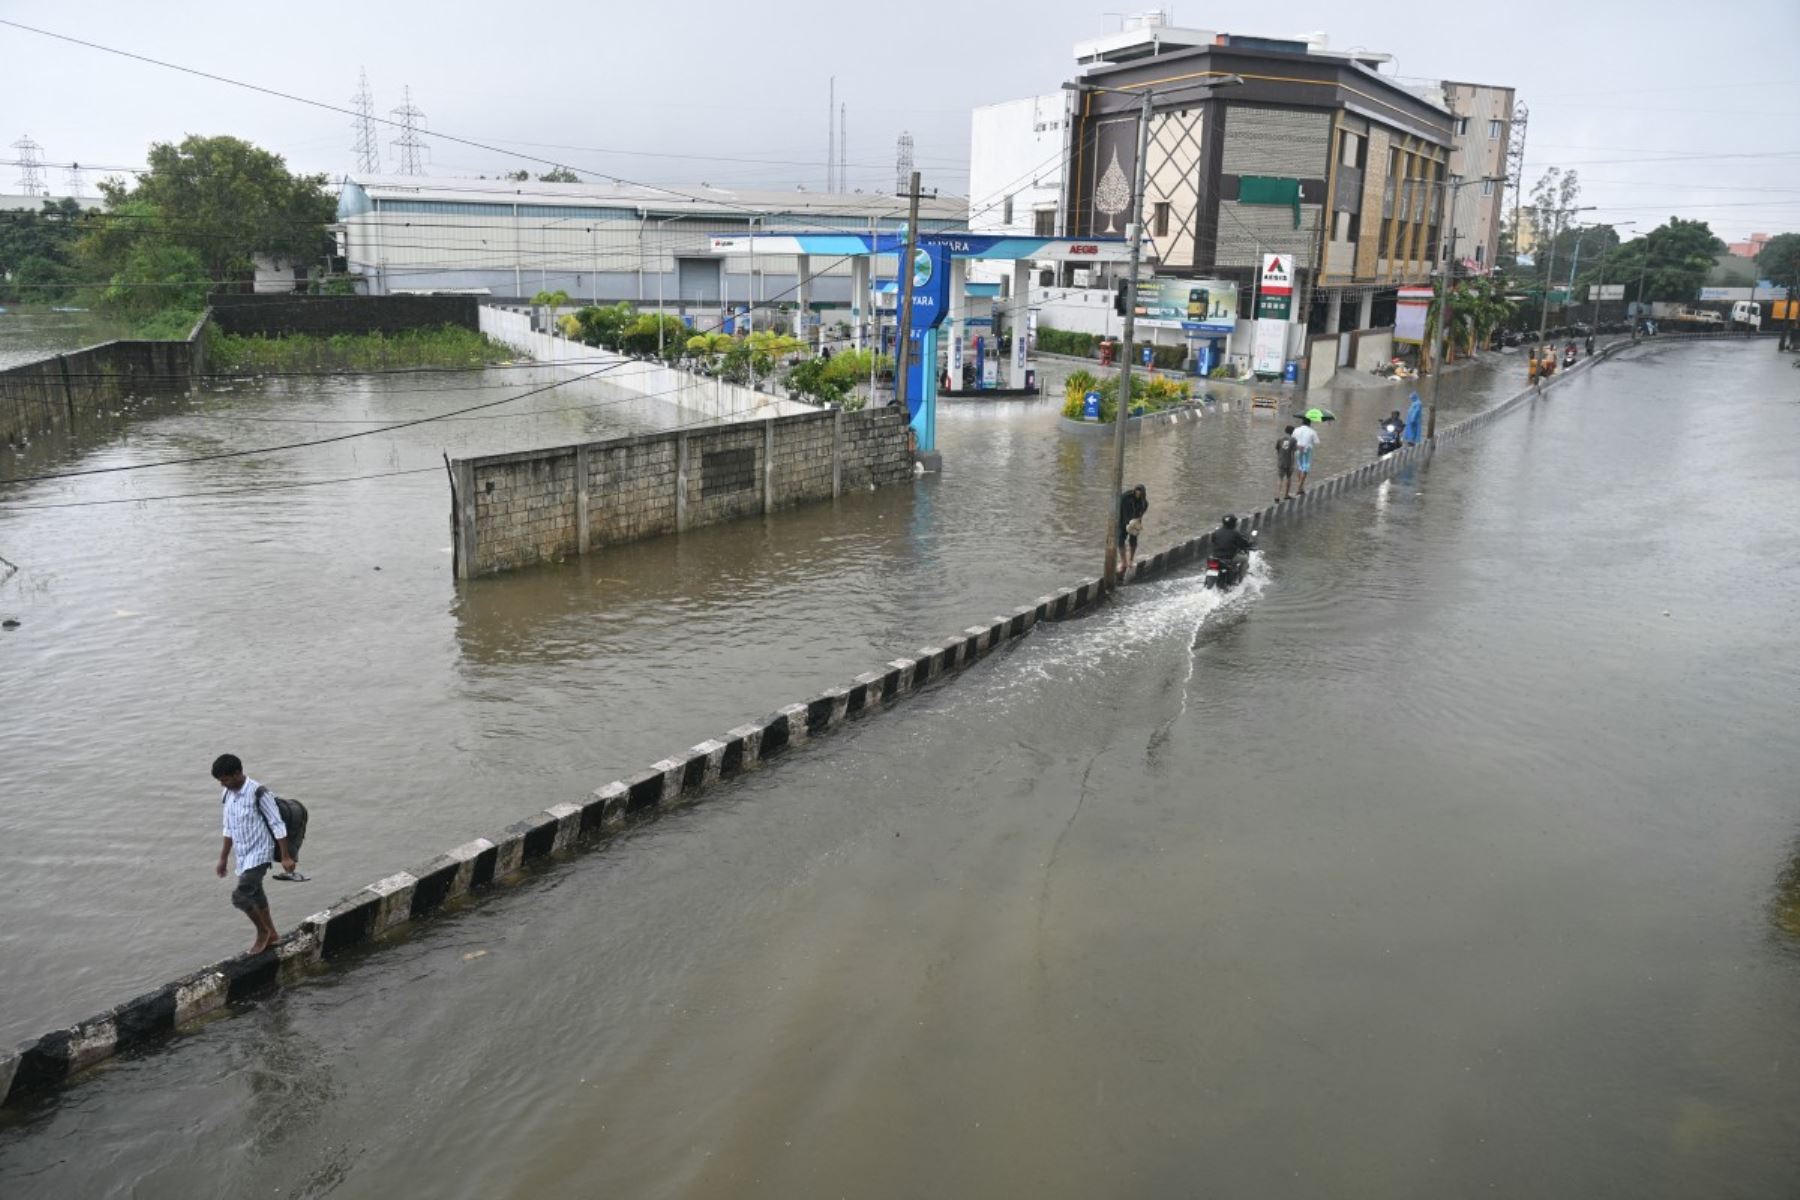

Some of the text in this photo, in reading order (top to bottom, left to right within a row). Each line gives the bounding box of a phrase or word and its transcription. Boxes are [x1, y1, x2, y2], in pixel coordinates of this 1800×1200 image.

[928, 241, 970, 251] YARA
[1069, 245, 1098, 254] AEGIS
[901, 295, 934, 306] YARA
